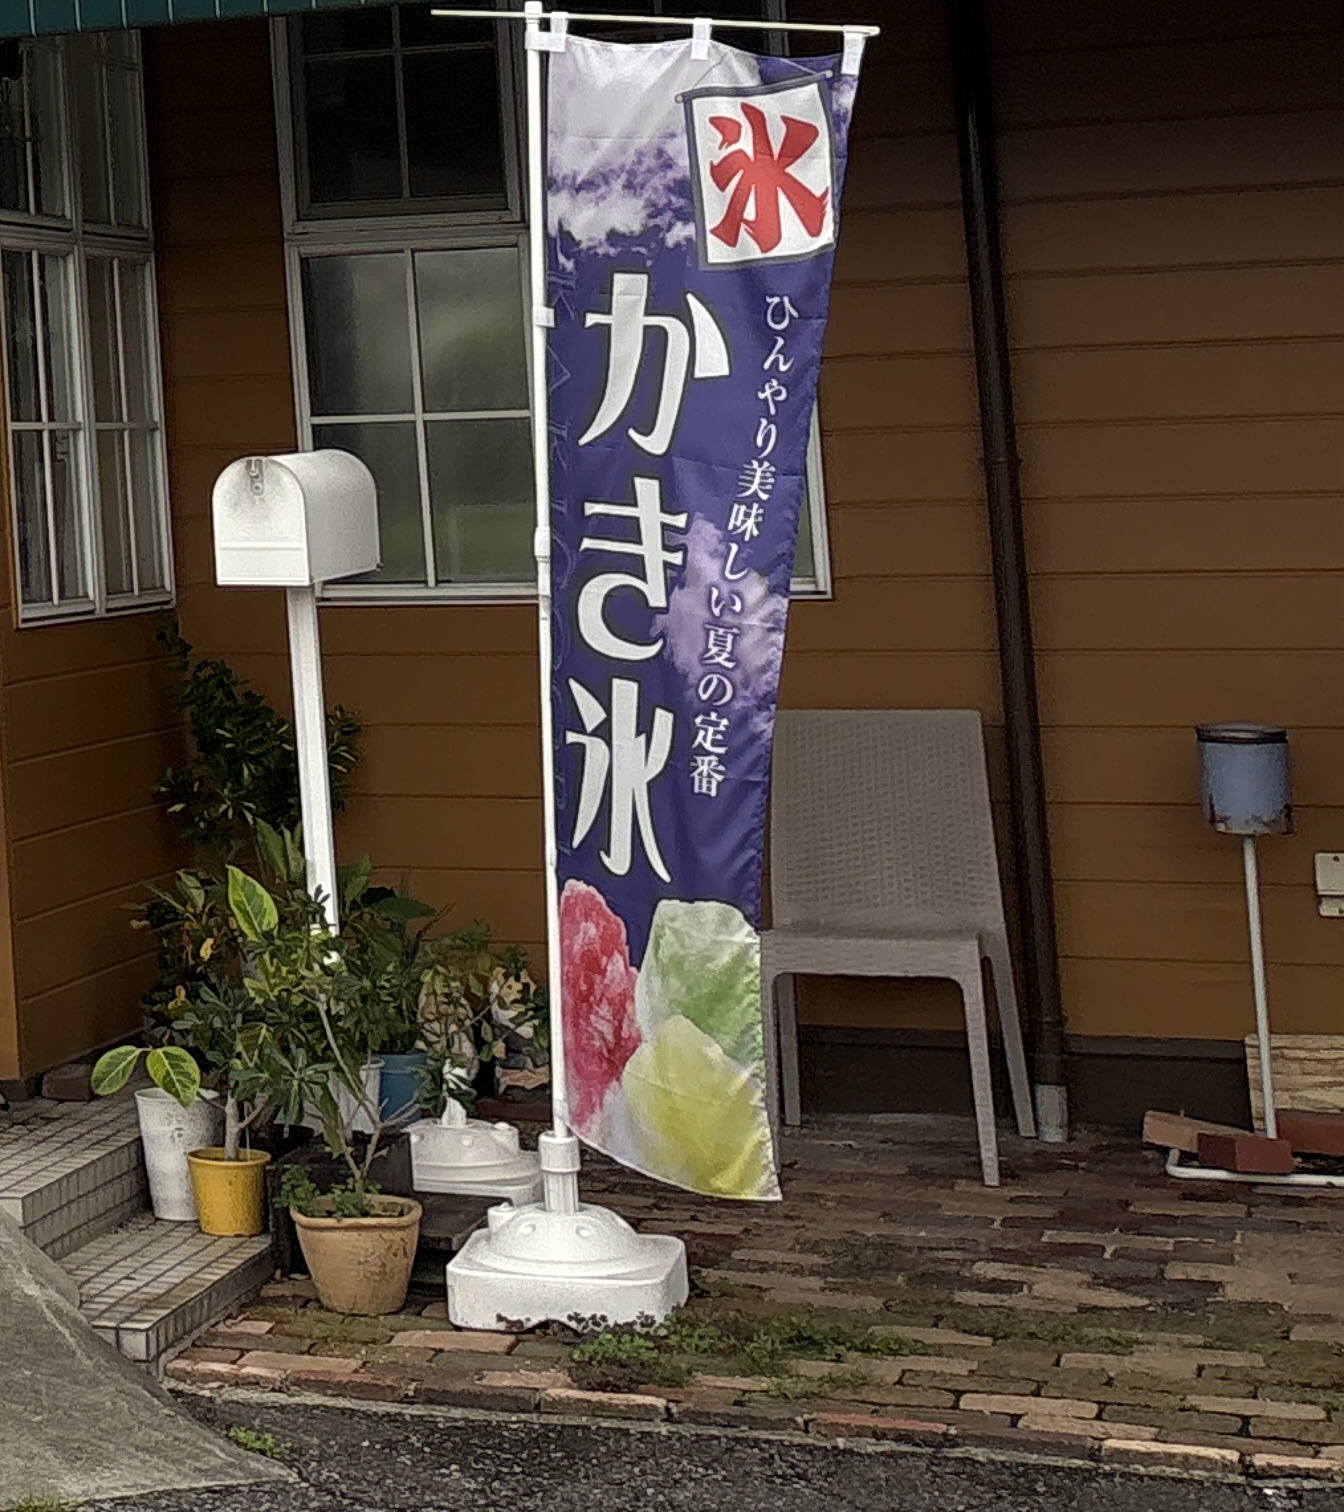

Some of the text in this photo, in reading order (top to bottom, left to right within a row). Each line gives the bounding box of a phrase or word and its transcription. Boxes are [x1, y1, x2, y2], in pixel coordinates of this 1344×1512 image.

[708, 101, 831, 254] 氷
[565, 272, 731, 883] かき氷
[689, 294, 800, 799] ひんやり美味しい夏の定番
